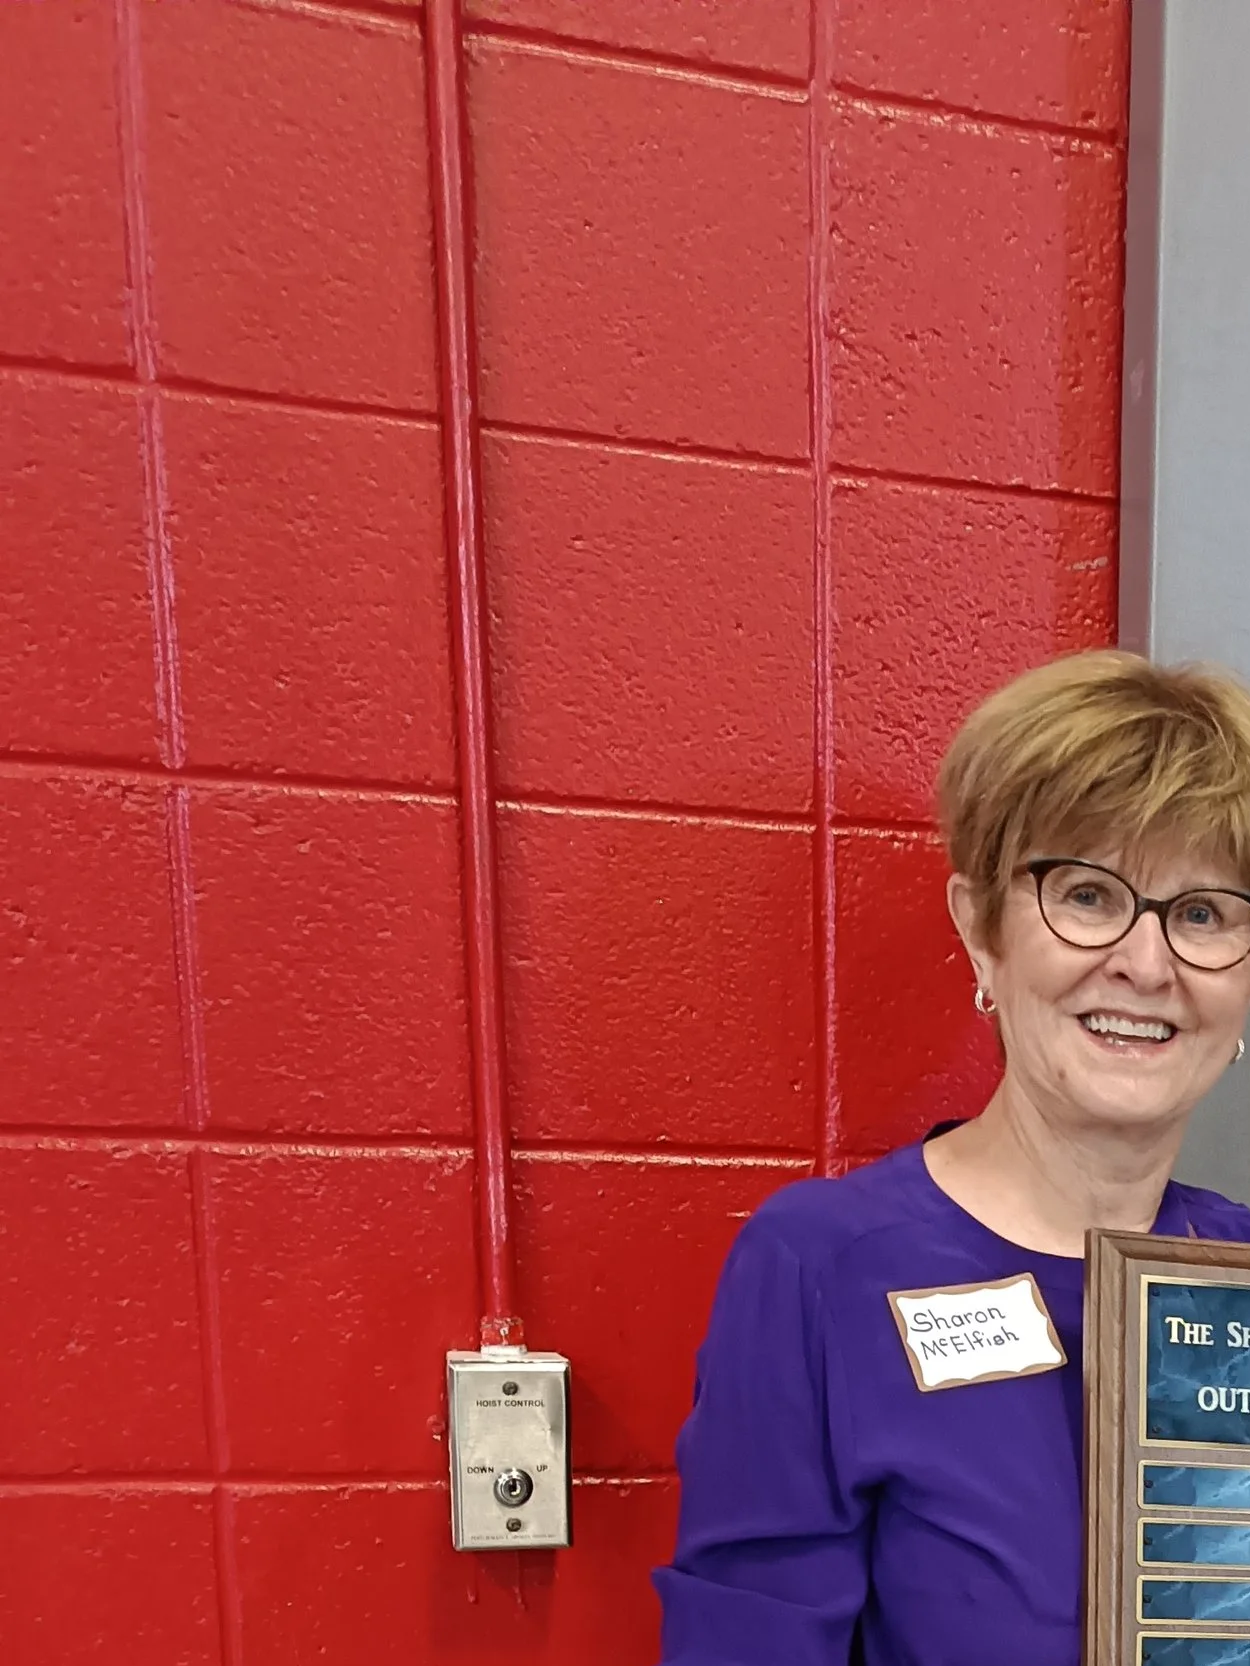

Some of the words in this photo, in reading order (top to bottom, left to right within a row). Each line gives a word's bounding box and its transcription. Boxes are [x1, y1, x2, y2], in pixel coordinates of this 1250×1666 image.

[910, 1307, 1006, 1332] Sharon
[1165, 1316, 1214, 1347] THE
[920, 1326, 1020, 1360] McElfish
[476, 1399, 501, 1408] HOIST
[504, 1399, 545, 1408] CONTROL
[467, 1466, 494, 1475] DOWN
[536, 1465, 548, 1473] UP
